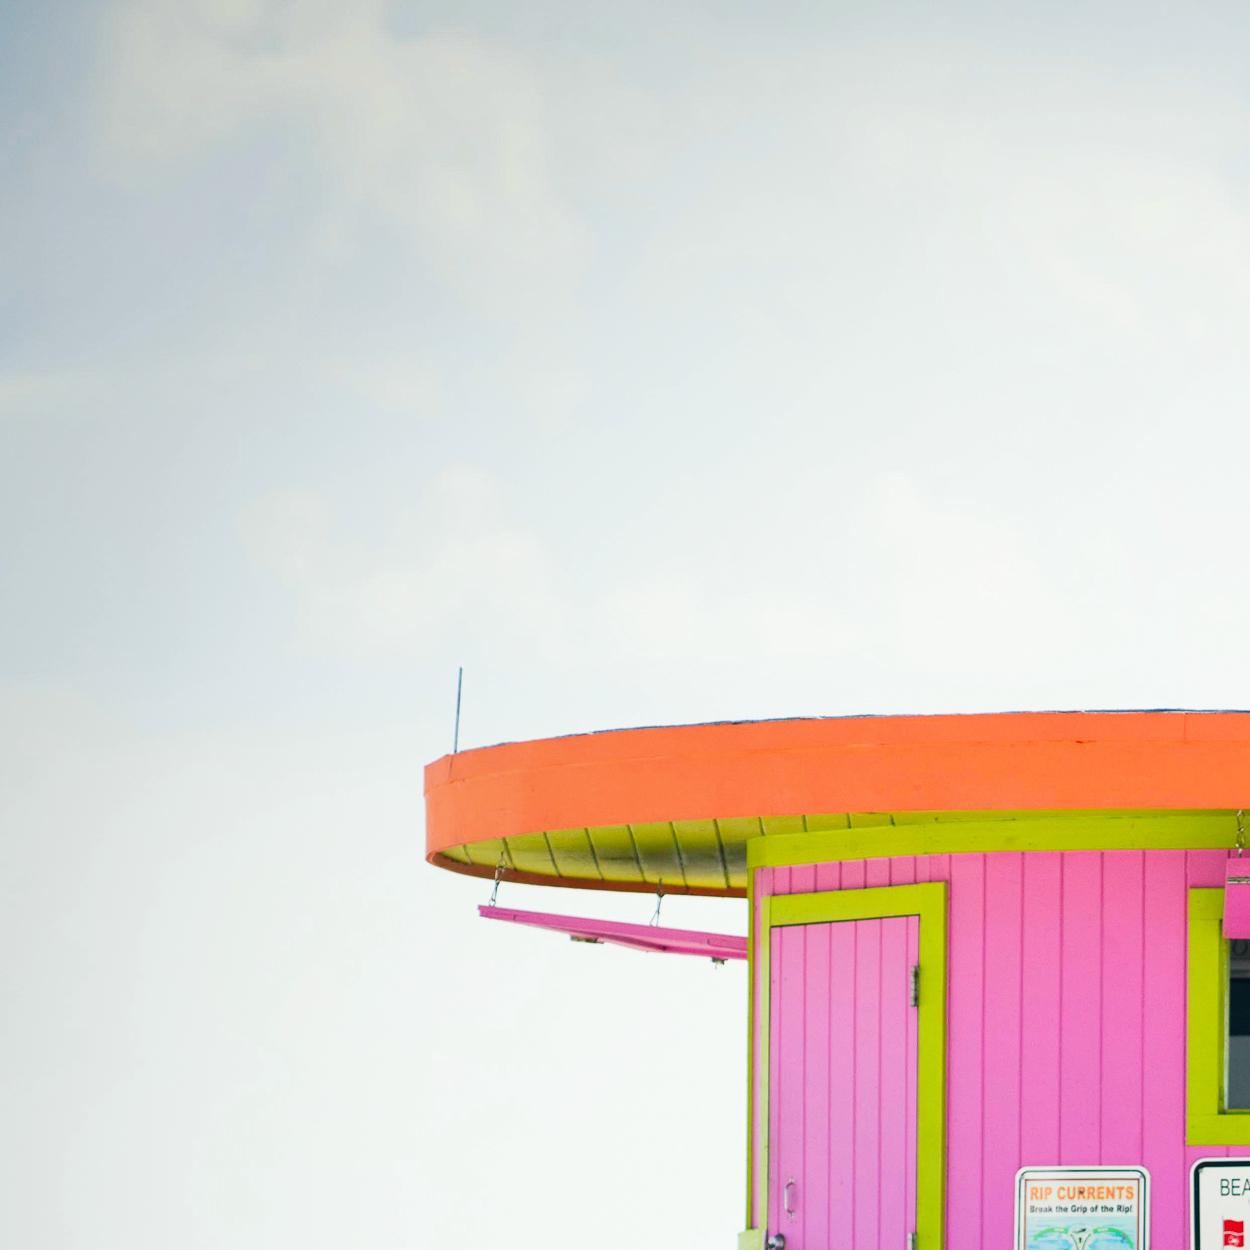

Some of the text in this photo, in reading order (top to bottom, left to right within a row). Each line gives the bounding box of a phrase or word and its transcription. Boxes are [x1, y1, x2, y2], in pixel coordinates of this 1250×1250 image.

[1030, 1186, 1135, 1200] RIP CURRENTS
[1030, 1205, 1133, 1214] Break the Grip of the Rip!
